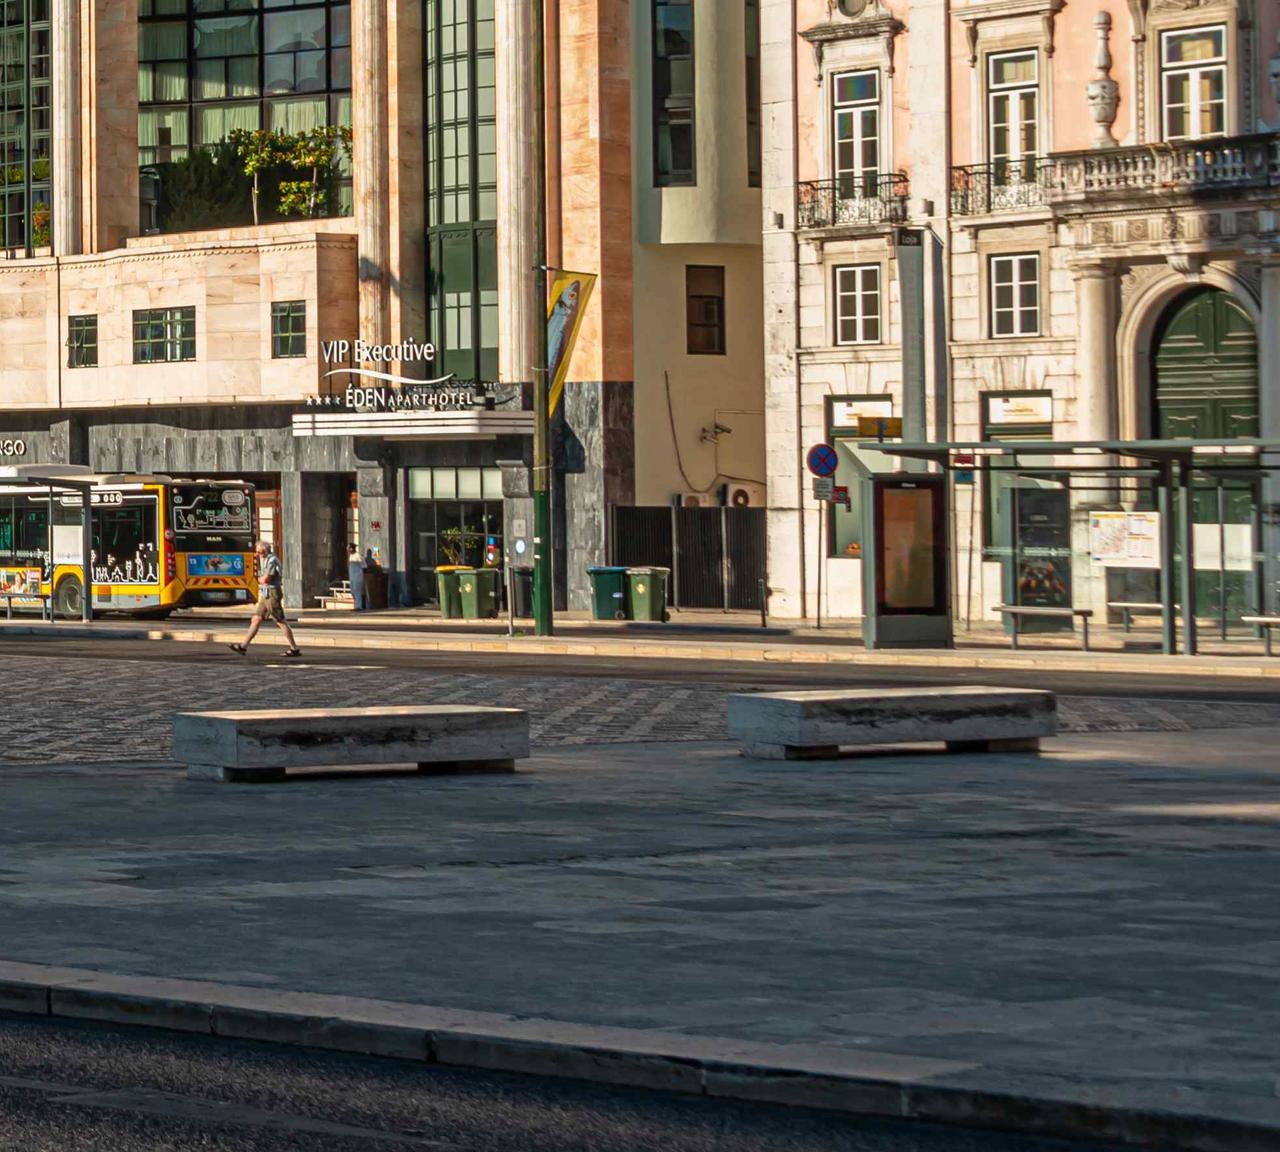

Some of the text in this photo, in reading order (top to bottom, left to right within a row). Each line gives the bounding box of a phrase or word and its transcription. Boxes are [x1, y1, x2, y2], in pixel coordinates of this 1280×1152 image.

[321, 336, 436, 363] VIP Executive
[345, 383, 474, 408] ÉDEN APARTHOTEL
